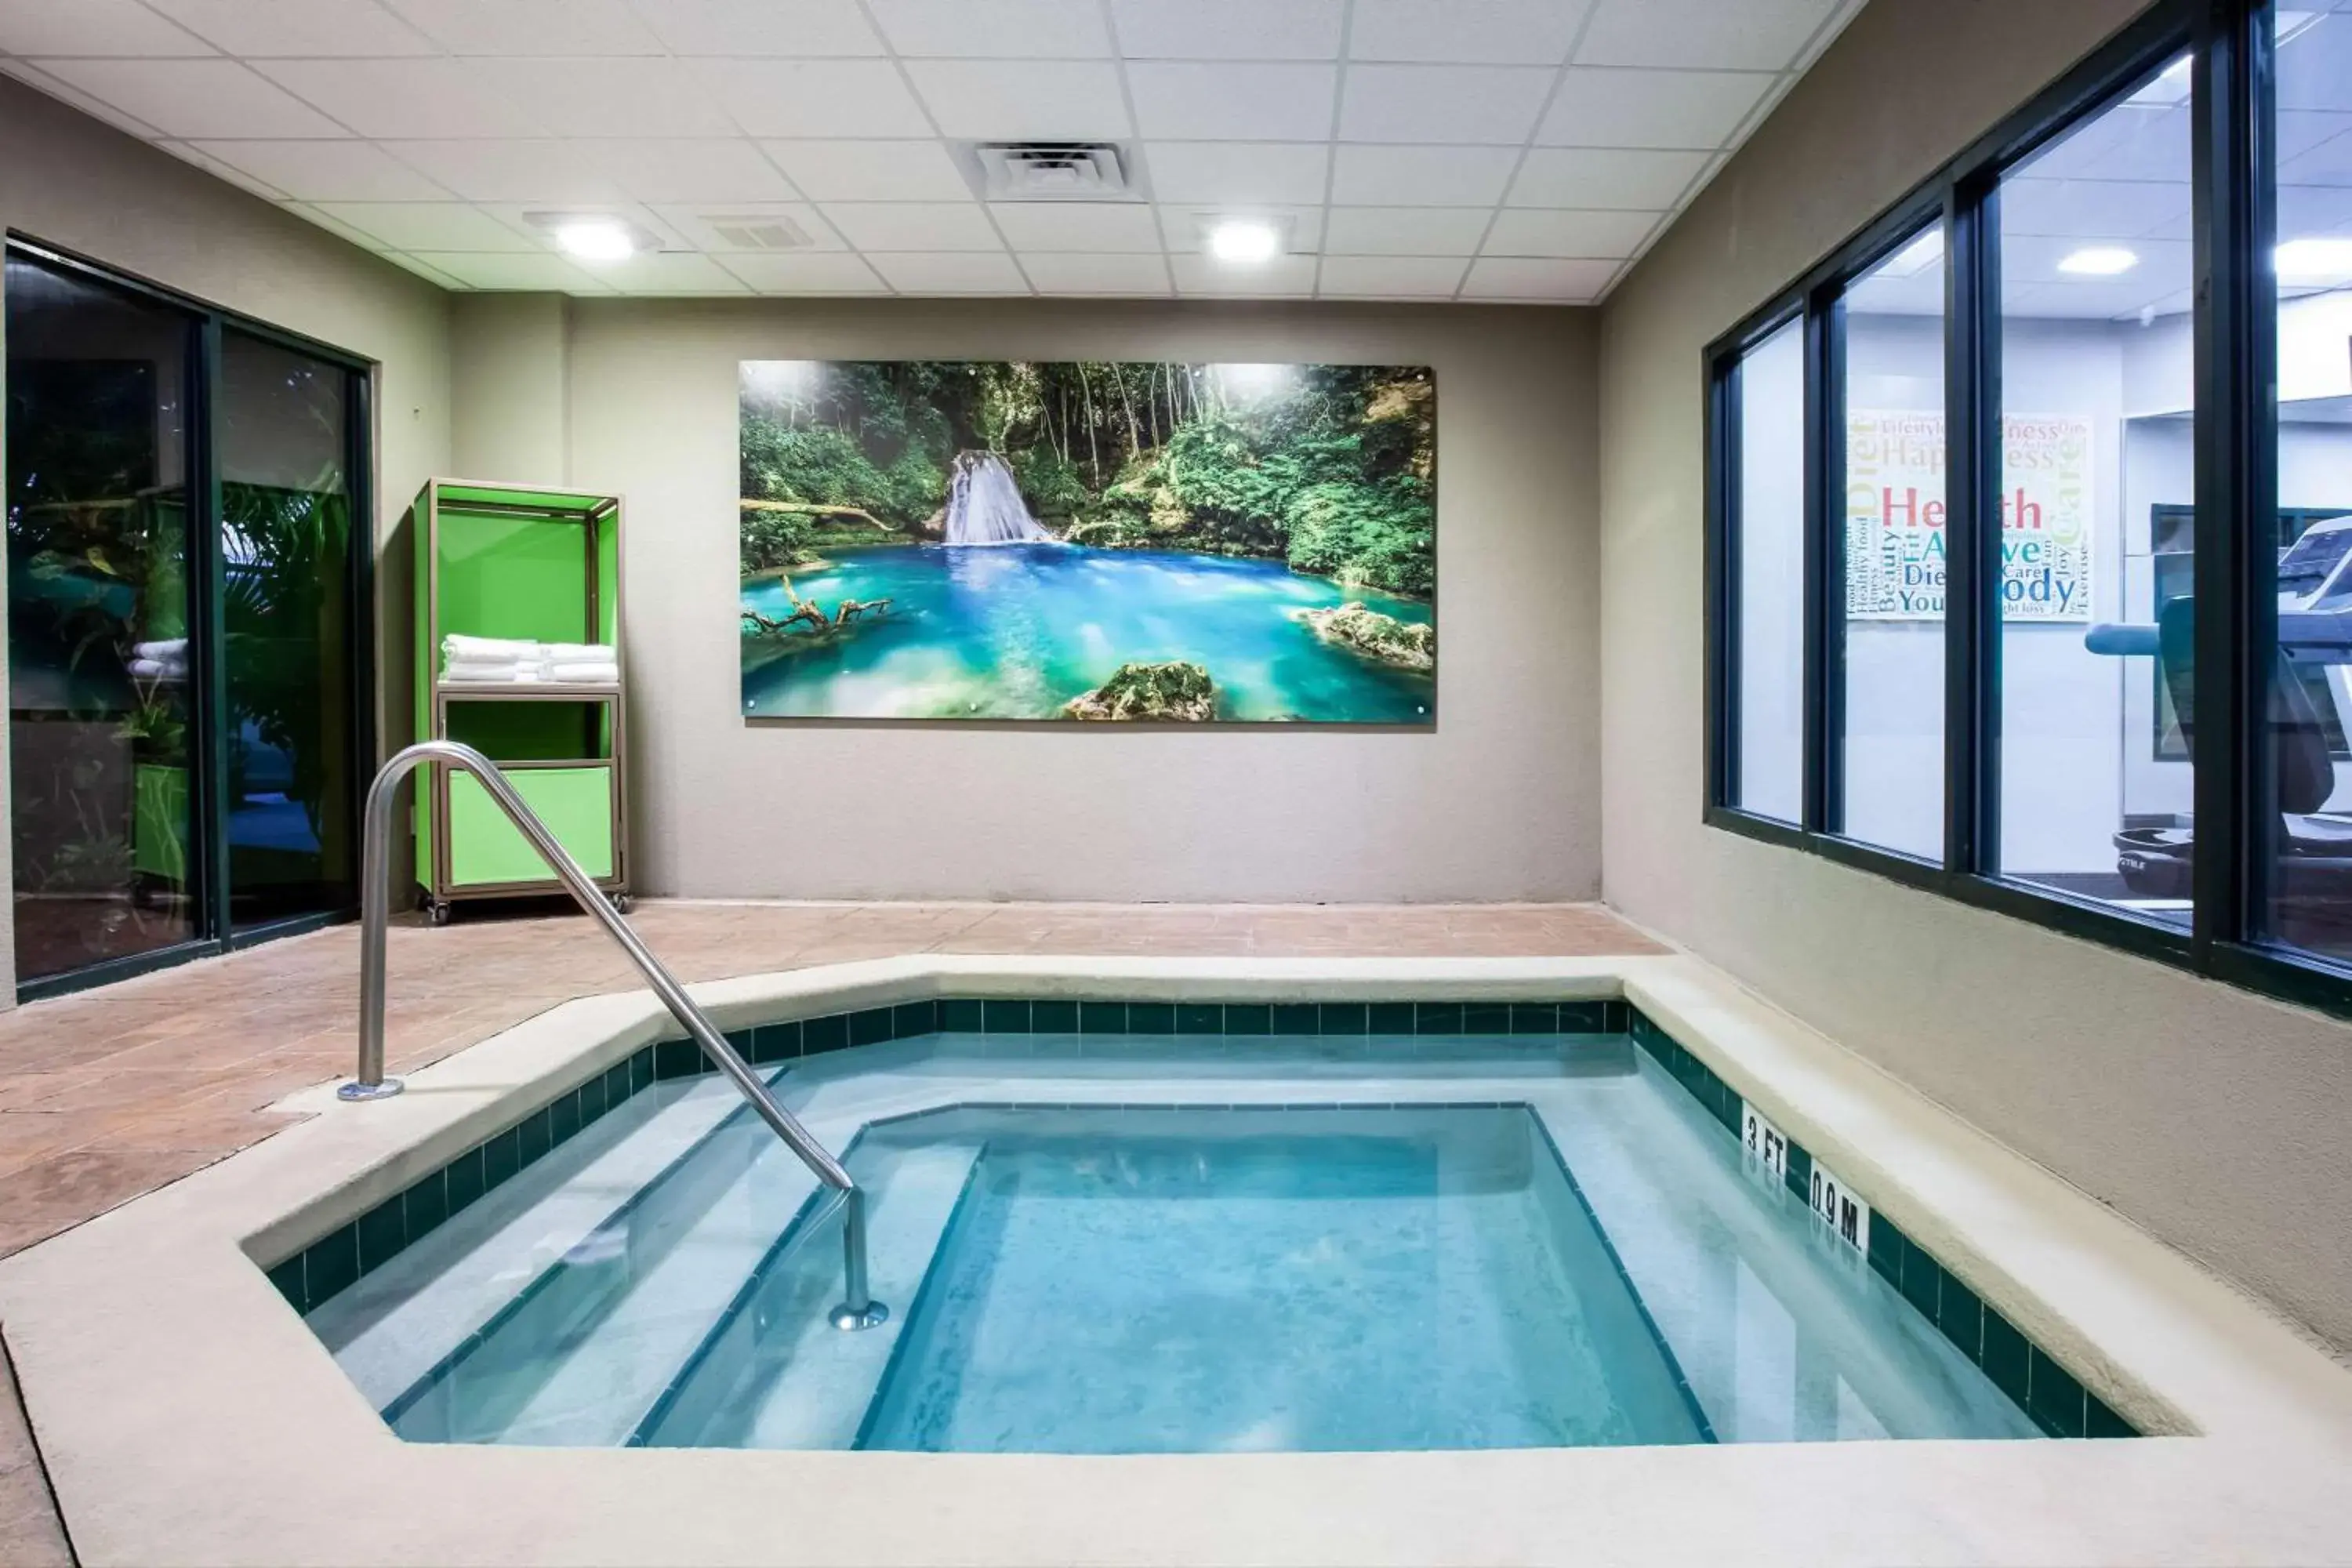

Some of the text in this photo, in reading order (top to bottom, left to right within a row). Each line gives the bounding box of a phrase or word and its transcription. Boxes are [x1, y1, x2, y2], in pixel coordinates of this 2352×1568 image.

[1882, 419, 1945, 437] Lifestyl
[1883, 438, 2054, 475] Hapess
[1883, 487, 2042, 529] Heth
[1922, 531, 2041, 564] Ave
[1879, 530, 1901, 612] Beauty
[1904, 564, 1946, 586] Die
[2003, 563, 2042, 578] Care
[2003, 568, 2076, 613] ody
[1748, 1115, 1784, 1174] 3 FT
